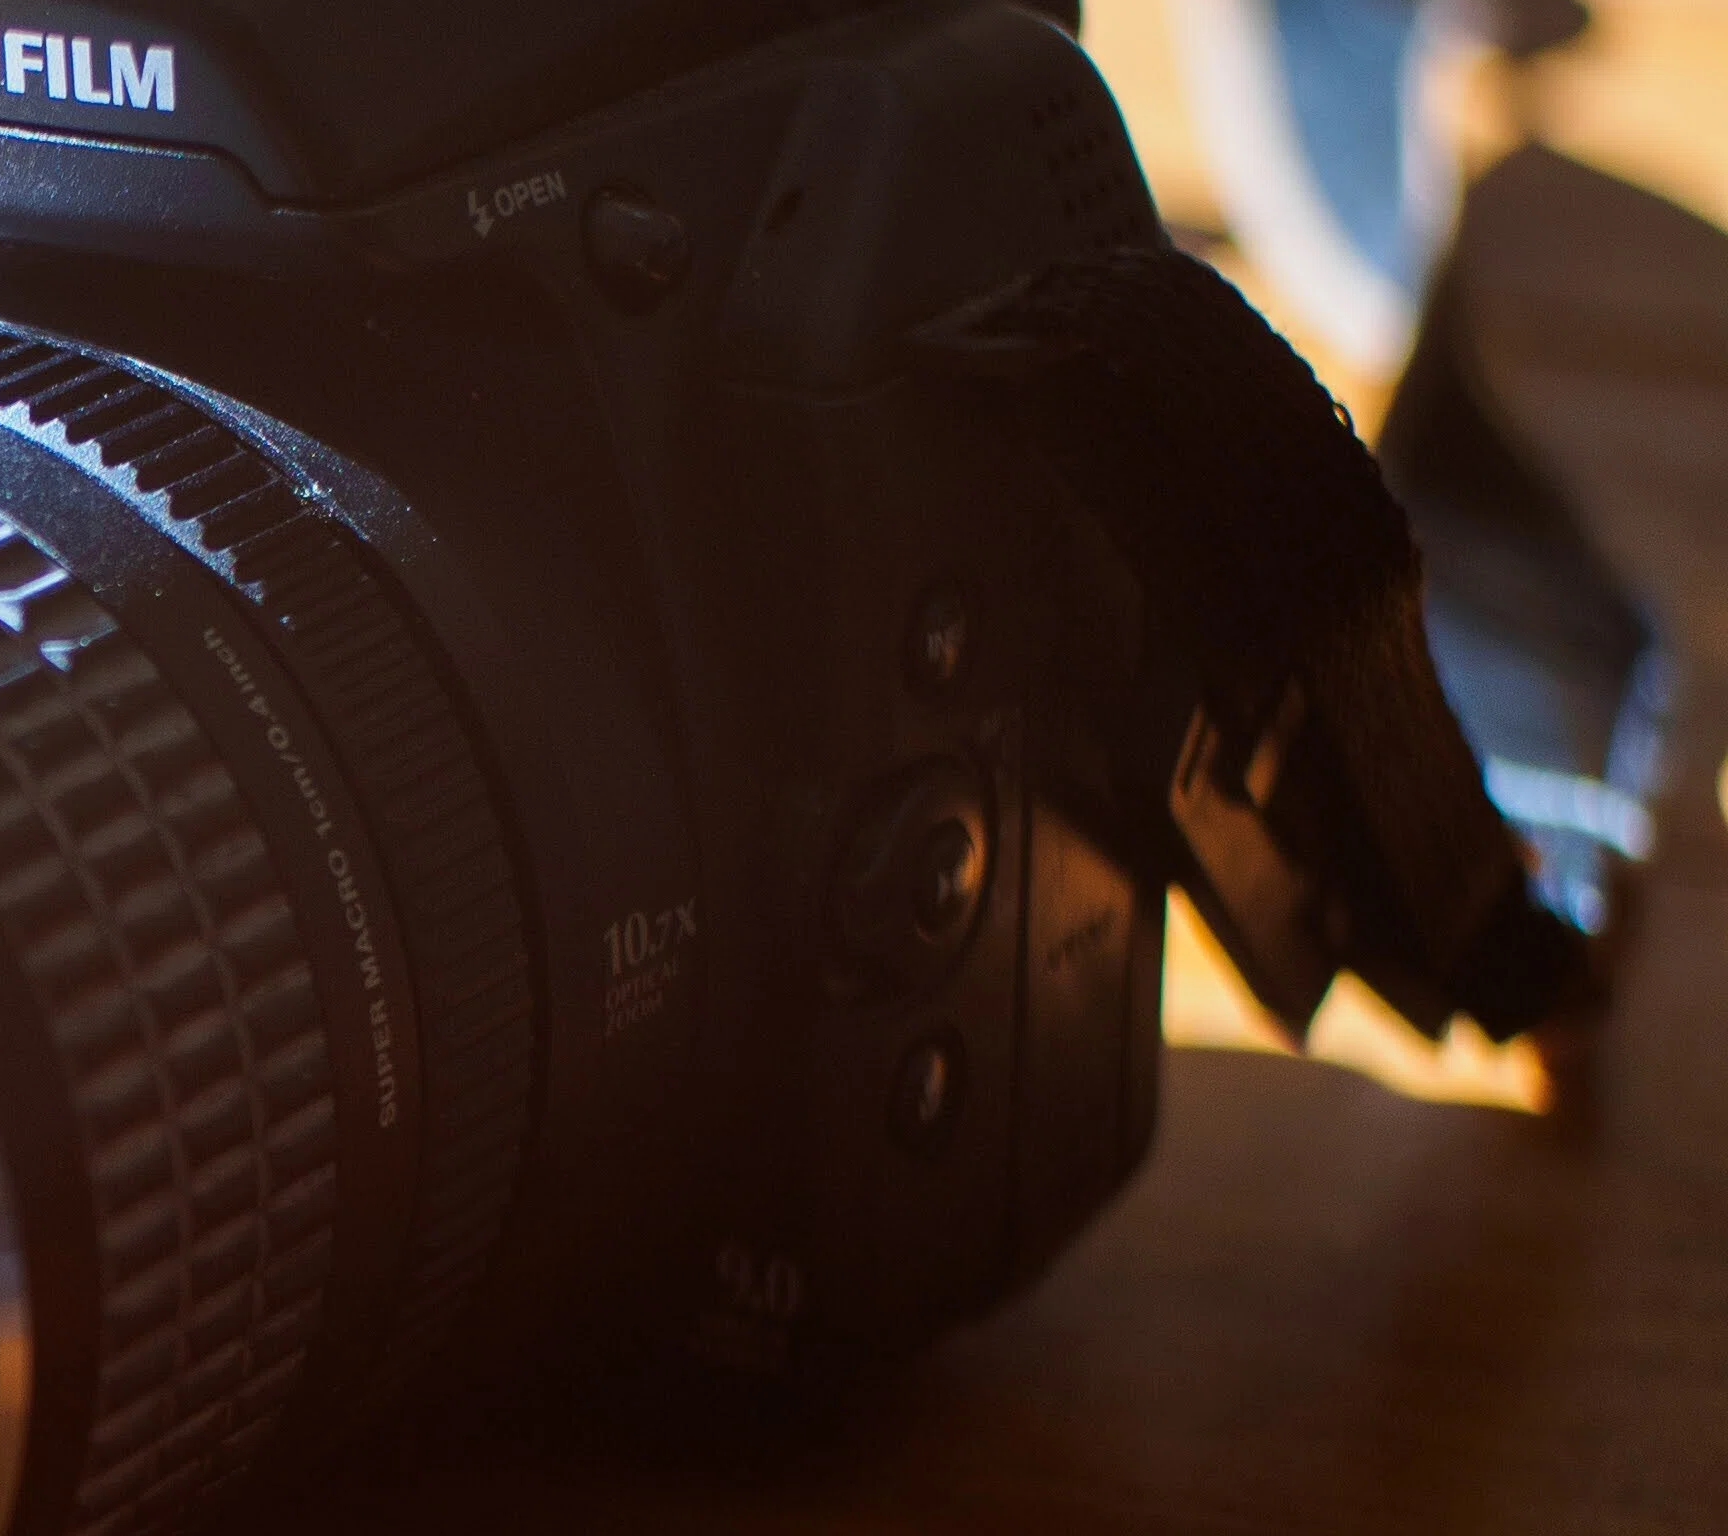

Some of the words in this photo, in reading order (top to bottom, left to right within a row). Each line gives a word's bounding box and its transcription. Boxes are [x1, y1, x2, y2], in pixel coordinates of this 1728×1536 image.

[494, 169, 568, 217] OPEN
[327, 848, 383, 989] MACRO
[370, 998, 397, 1128] SUPER
